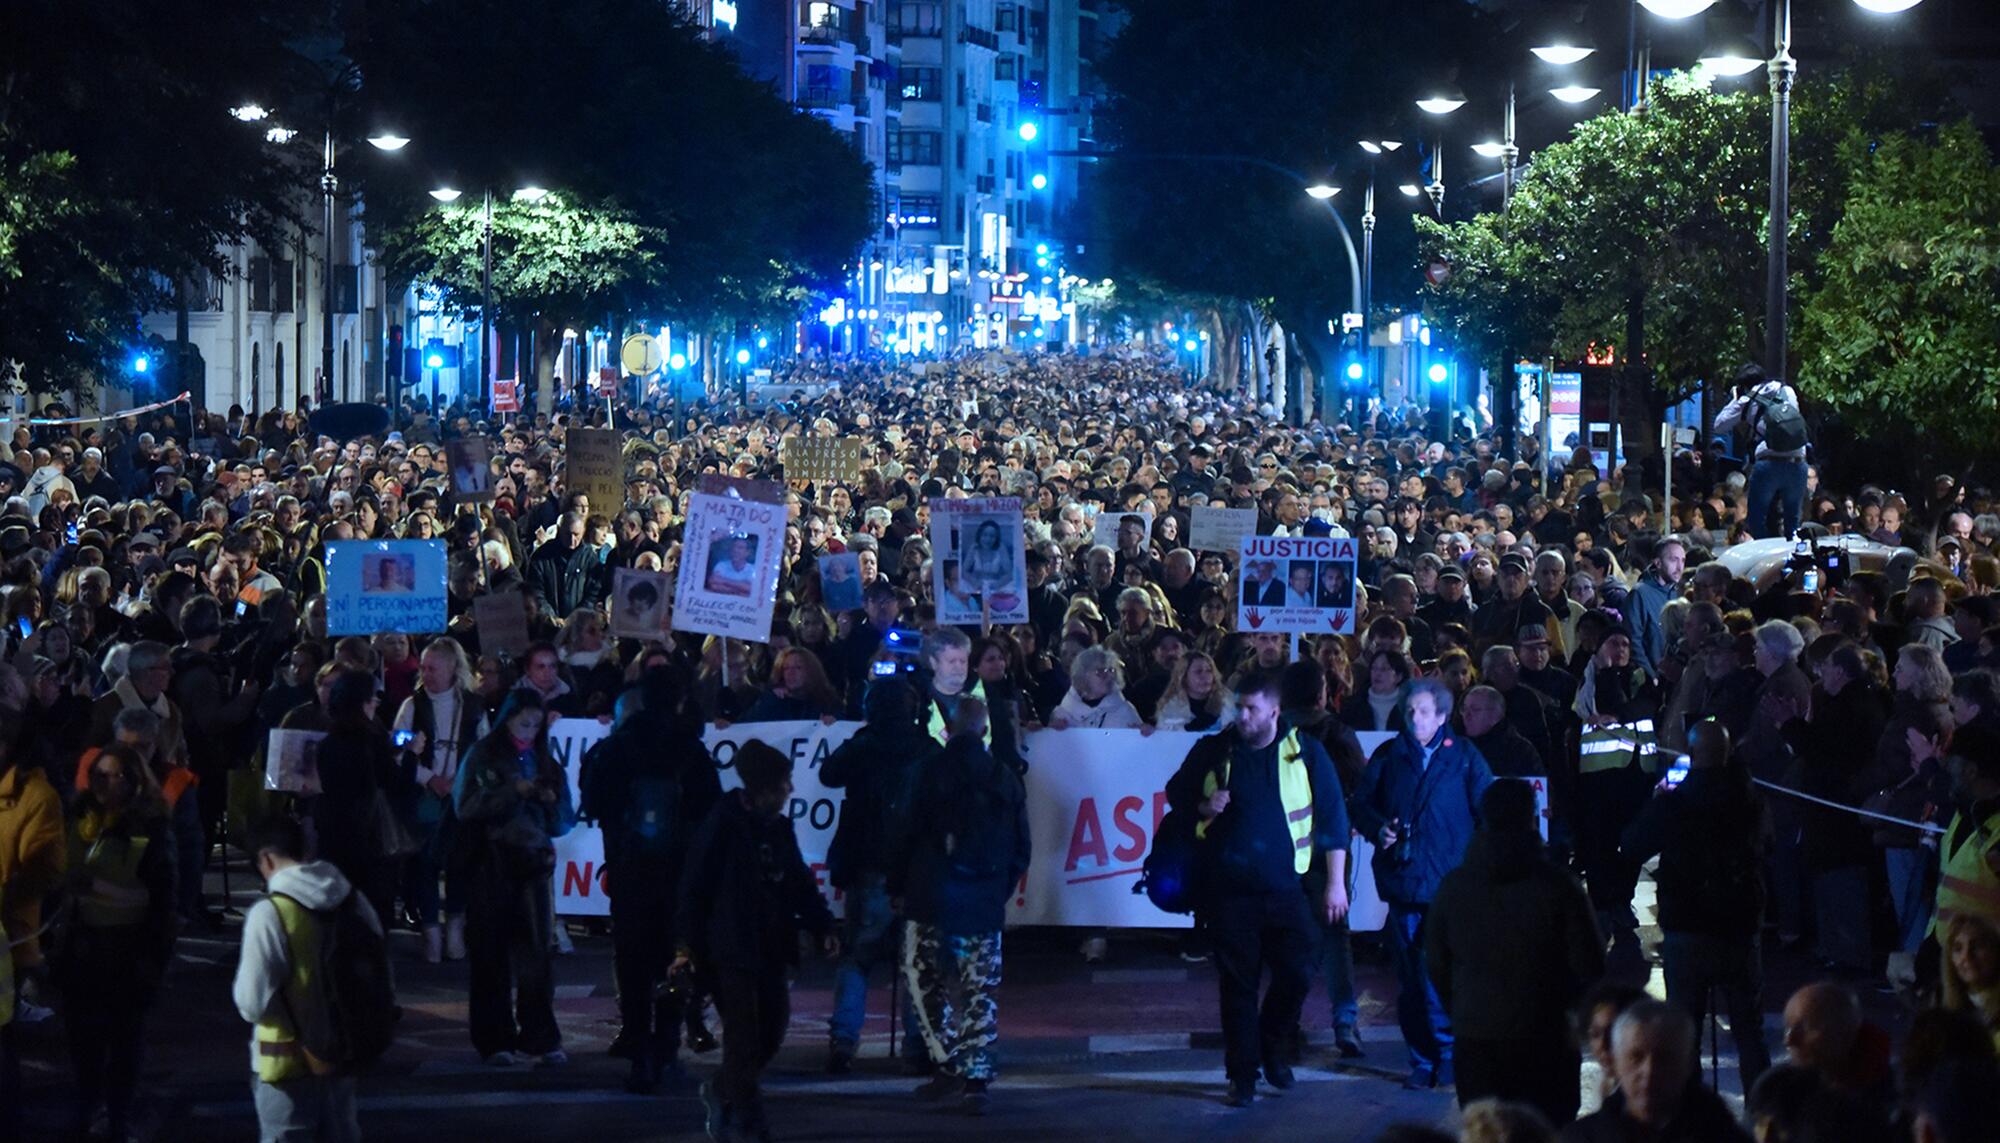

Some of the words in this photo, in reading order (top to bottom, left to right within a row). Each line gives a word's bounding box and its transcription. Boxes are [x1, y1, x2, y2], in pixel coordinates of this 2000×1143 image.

[793, 459, 847, 469] ROVIRA
[705, 501, 773, 524] MATADO
[1244, 539, 1355, 559] JUSTICIA
[358, 596, 446, 612] PERDONAMOS
[789, 798, 848, 831] PO
